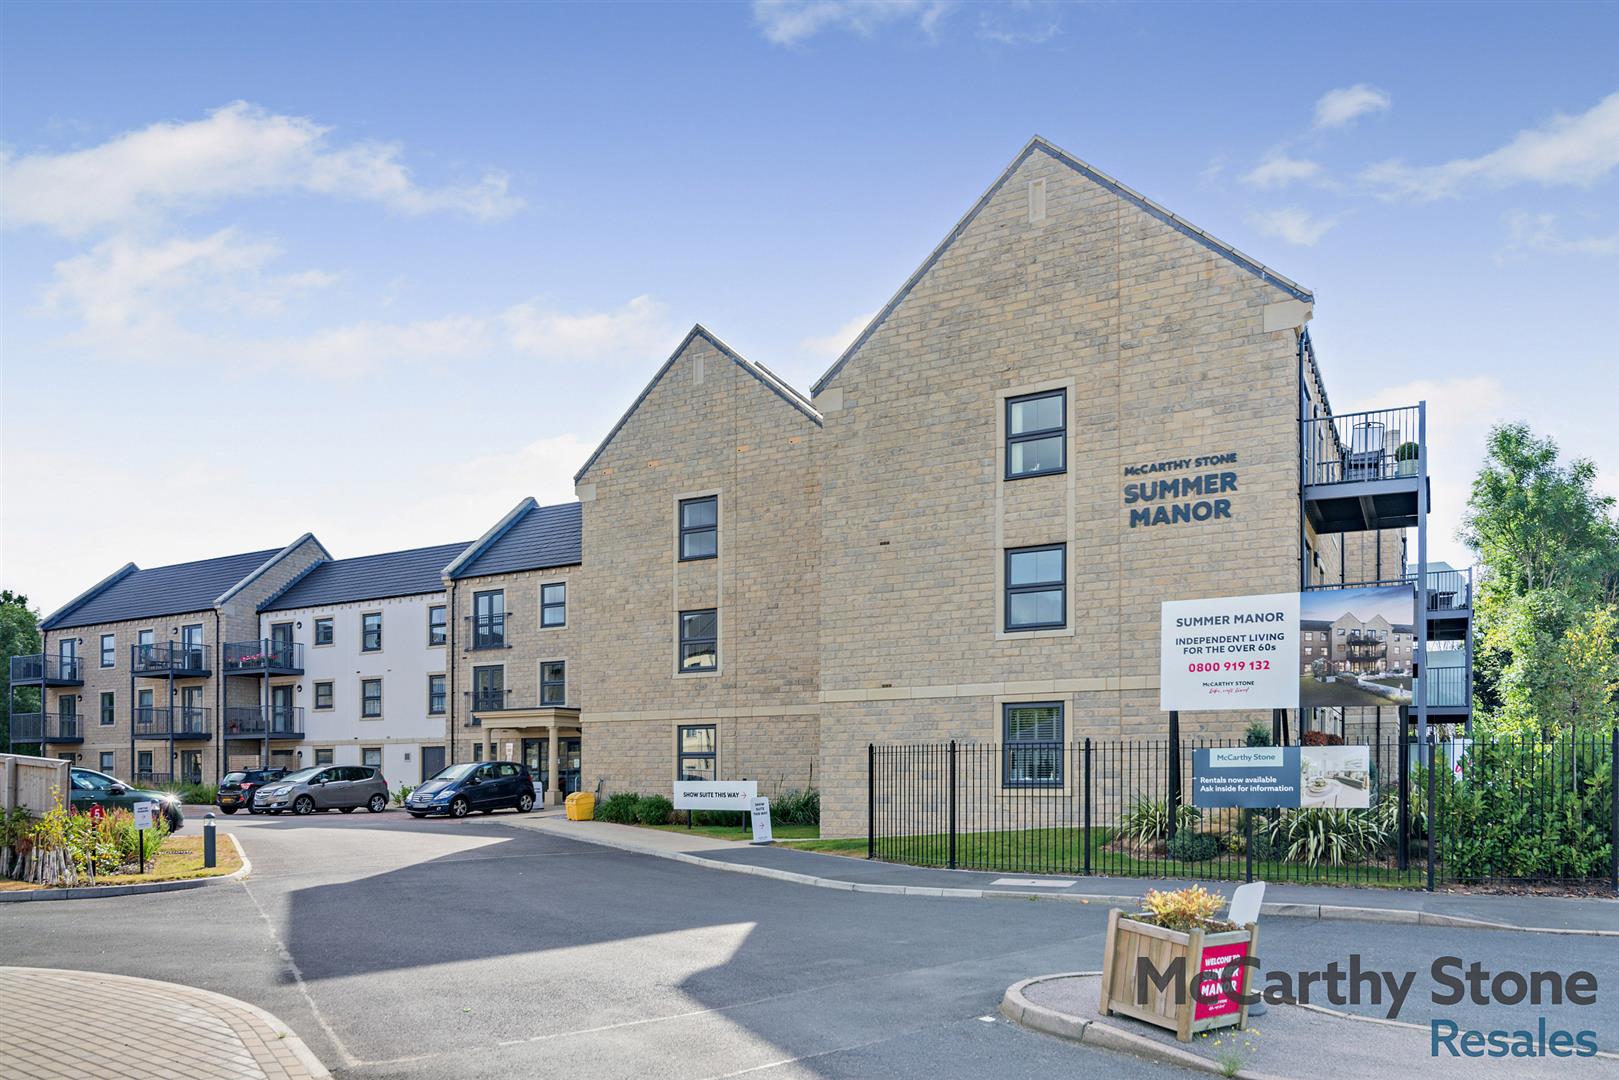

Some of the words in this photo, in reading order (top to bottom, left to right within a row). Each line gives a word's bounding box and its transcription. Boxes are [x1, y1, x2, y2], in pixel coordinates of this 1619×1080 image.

[1124, 458, 1191, 476] McCARTHY
[1195, 452, 1237, 467] STONE
[1124, 471, 1238, 504] SUMMER
[1130, 499, 1231, 528] MANOR
[1176, 615, 1230, 627] SUMMER
[1234, 612, 1285, 624] MANOR
[1175, 634, 1247, 646] INDEPENDENT
[1249, 632, 1285, 642] LIVING
[1183, 646, 1203, 655] FOR
[1205, 645, 1225, 654] THE
[1227, 644, 1256, 653] OVER
[1258, 643, 1276, 652] 60s
[1188, 662, 1220, 673] 0800
[1223, 661, 1245, 671] 919
[1249, 660, 1270, 670] 132
[1216, 753, 1252, 762] McCarthy
[1253, 753, 1276, 761] Stone
[1200, 776, 1227, 784] Rentals
[1244, 775, 1277, 784] available
[1200, 784, 1214, 793] Ask
[1214, 783, 1237, 793] inside
[1237, 783, 1249, 792] for
[1249, 783, 1294, 792] information
[1201, 980, 1237, 997] MANOR
